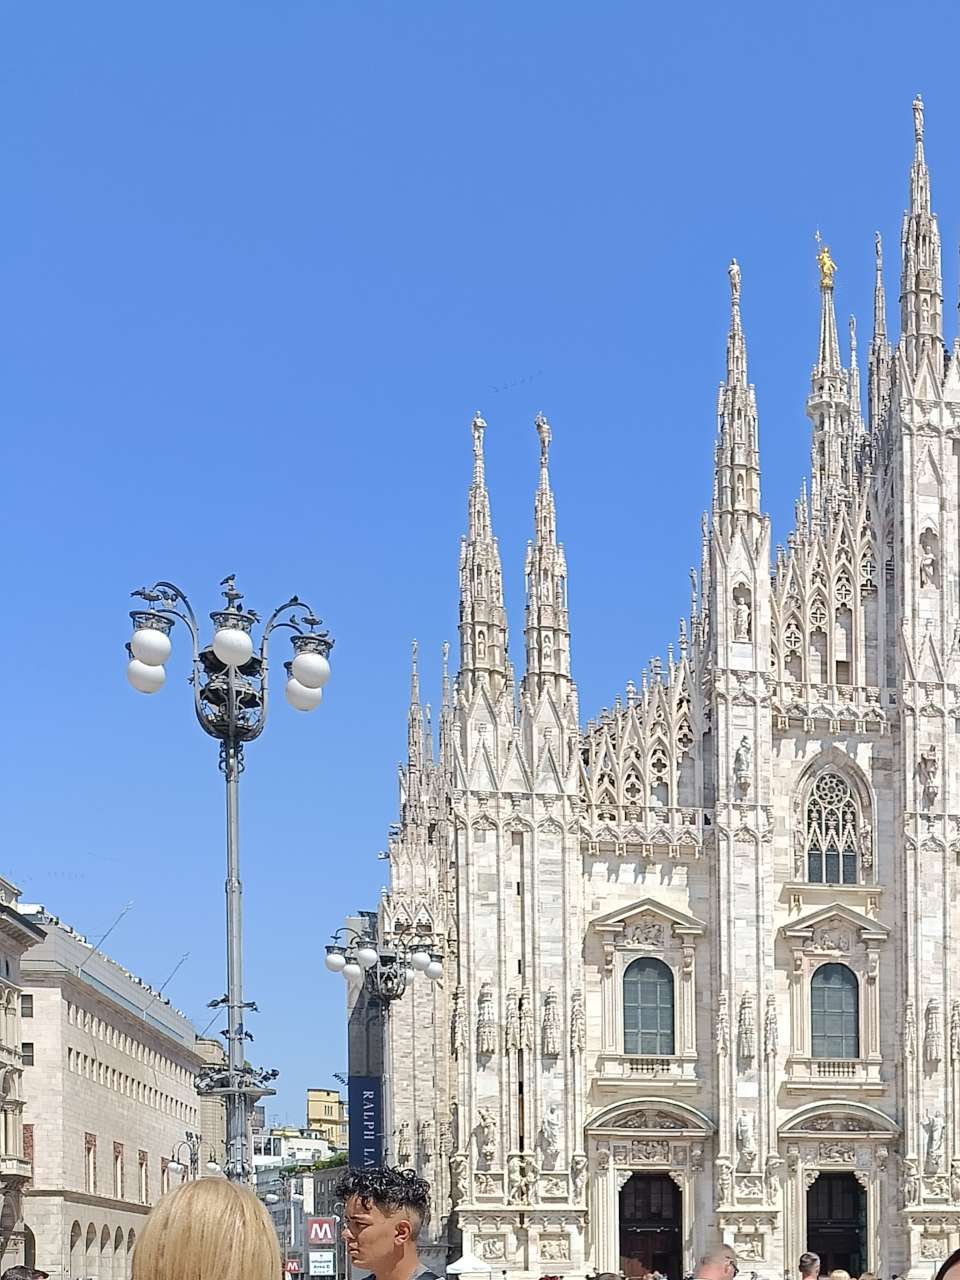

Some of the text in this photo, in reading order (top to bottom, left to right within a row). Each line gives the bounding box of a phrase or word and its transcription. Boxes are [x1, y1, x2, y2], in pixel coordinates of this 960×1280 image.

[363, 1090, 375, 1139] RALPH
[310, 1223, 332, 1239] M
[287, 1262, 299, 1270] M
